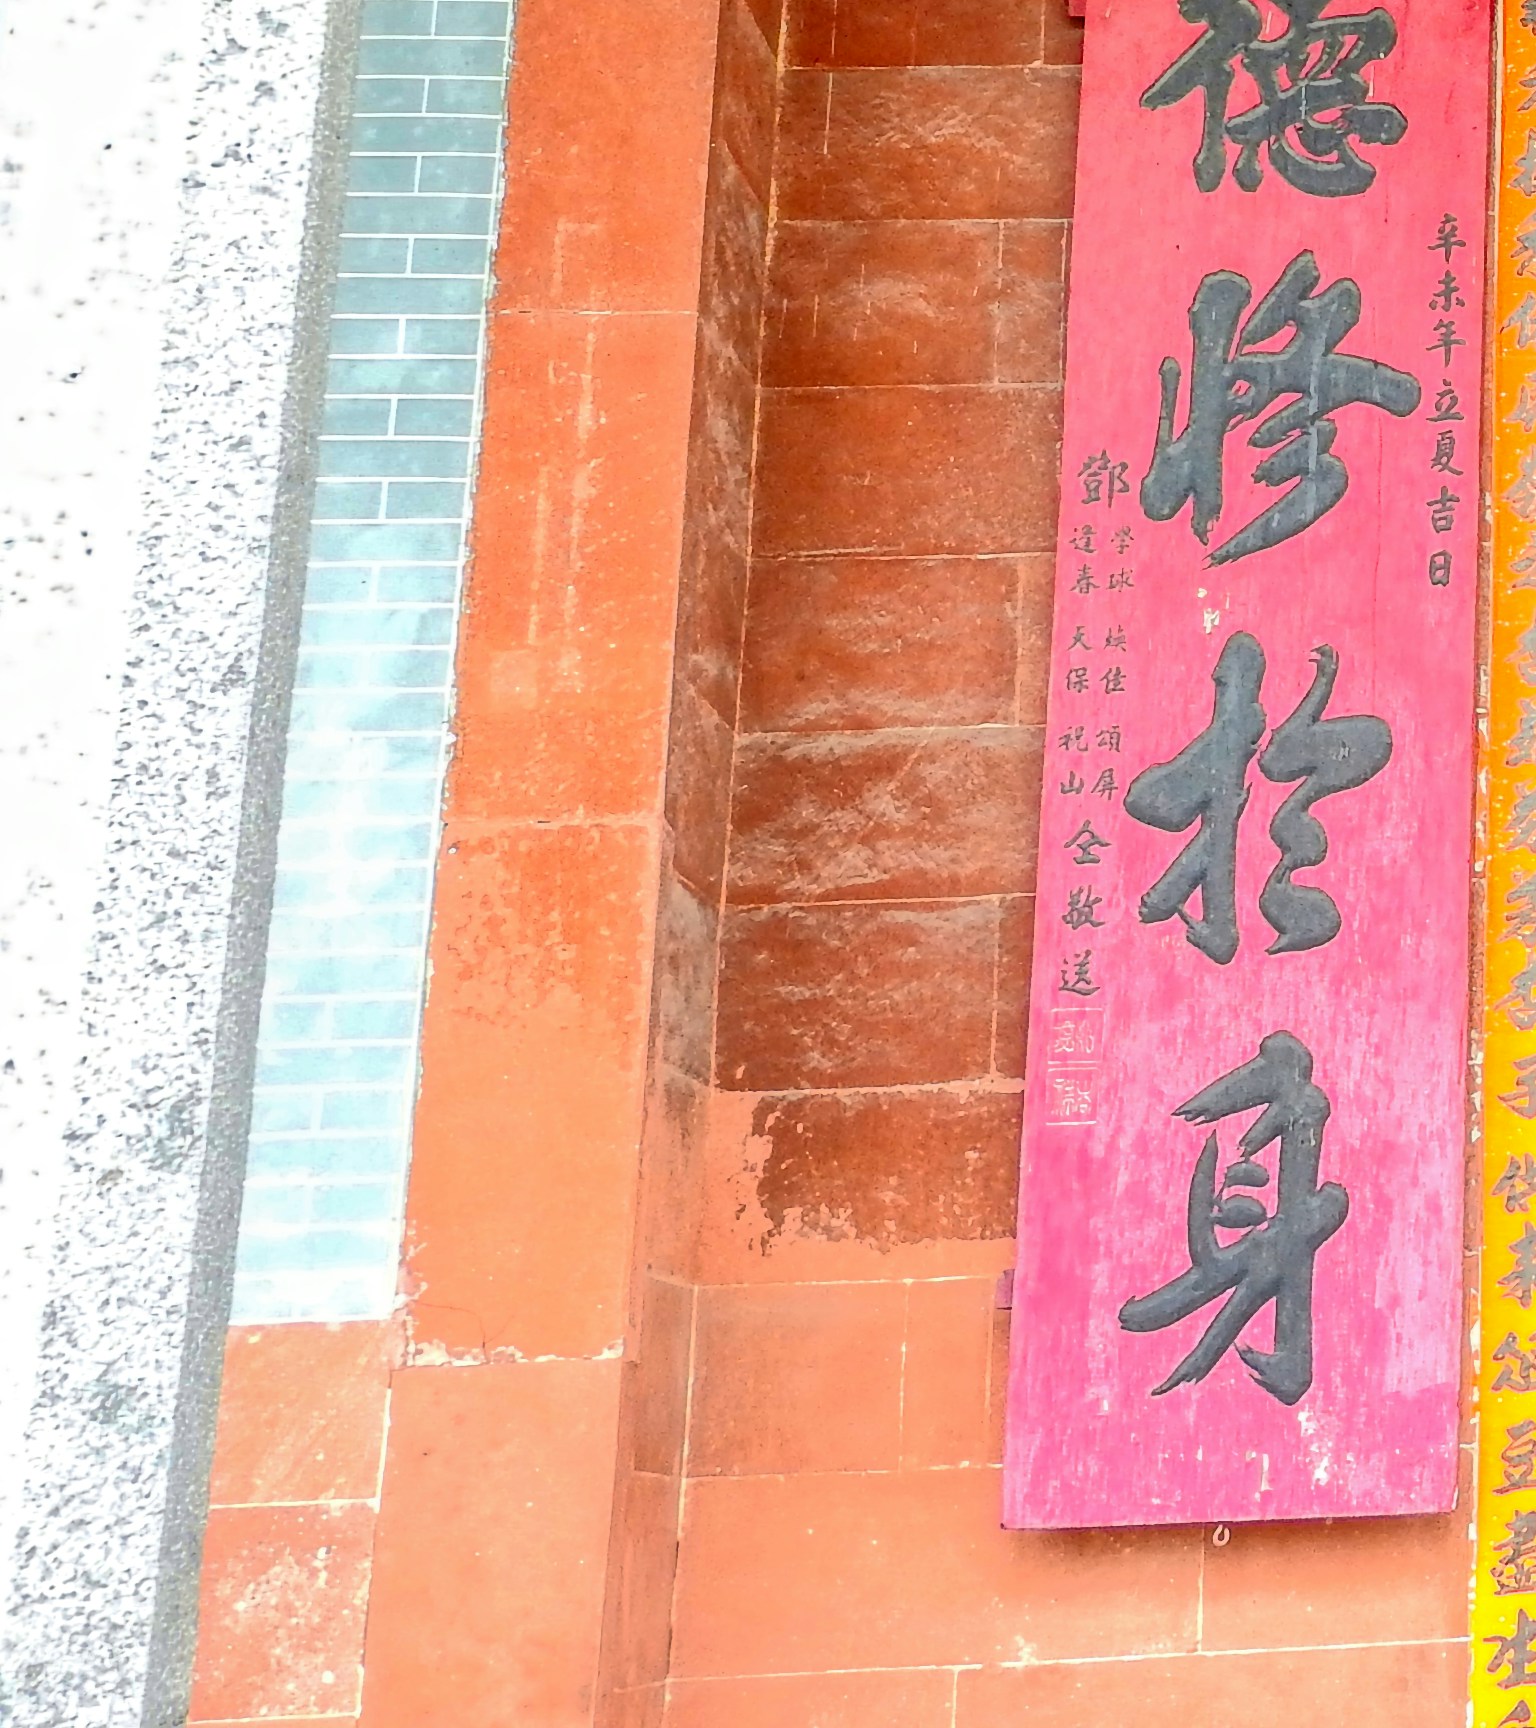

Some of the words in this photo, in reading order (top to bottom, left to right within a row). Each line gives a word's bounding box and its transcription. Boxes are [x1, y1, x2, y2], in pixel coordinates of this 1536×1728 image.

[1076, 448, 1131, 509] 鄧
[1426, 212, 1467, 587] 辛未年立夏吉日
